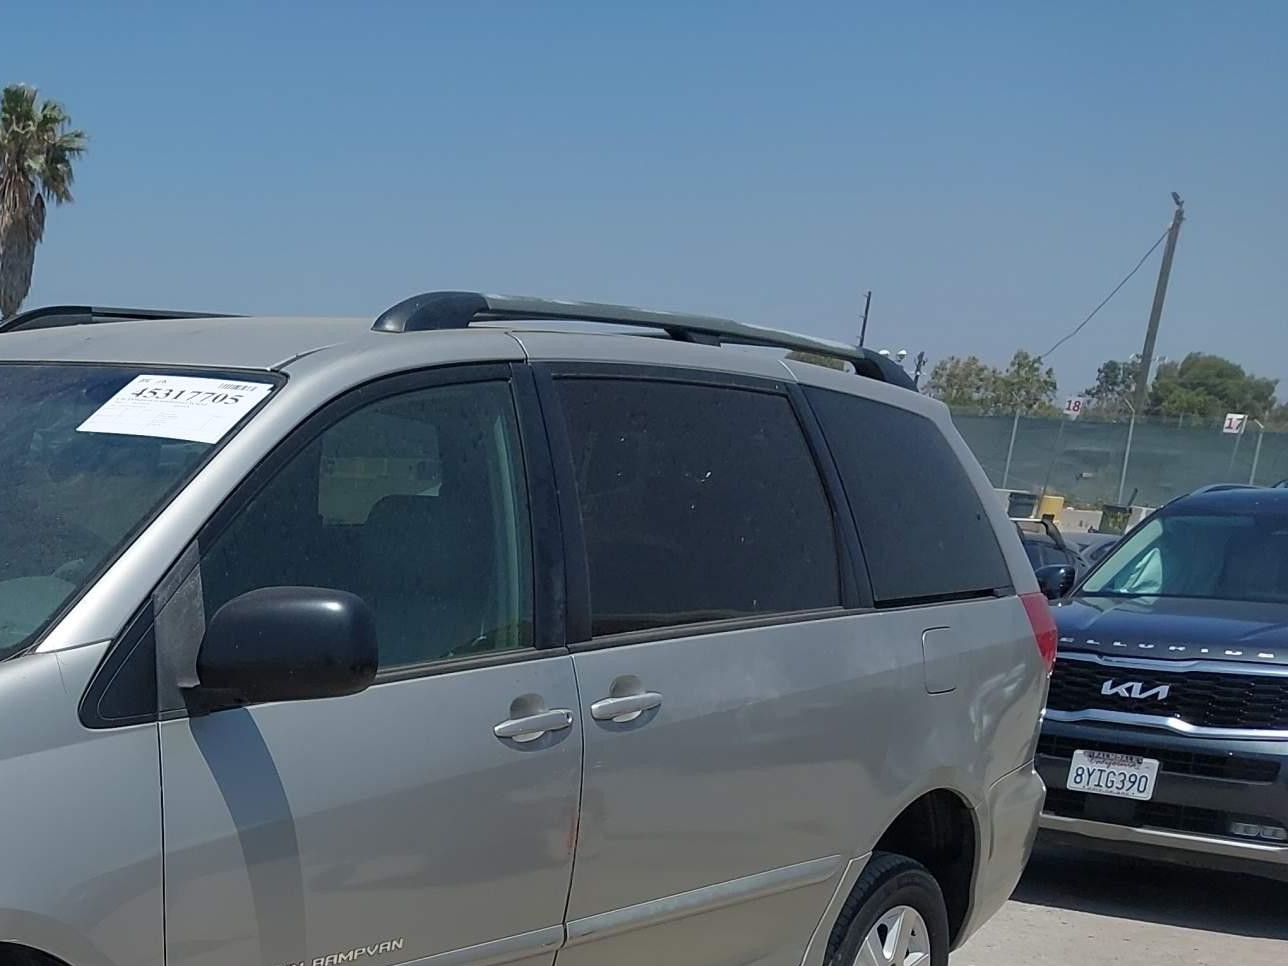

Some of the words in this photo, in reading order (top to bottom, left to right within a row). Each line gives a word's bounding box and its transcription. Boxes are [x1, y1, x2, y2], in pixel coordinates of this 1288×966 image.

[130, 386, 246, 405] 45317705
[1065, 399, 1082, 412] 18
[1223, 417, 1245, 430] 17
[1059, 636, 1275, 659] ELLURIDE
[1100, 679, 1171, 701] KIA
[1073, 766, 1149, 794] 8YIG390
